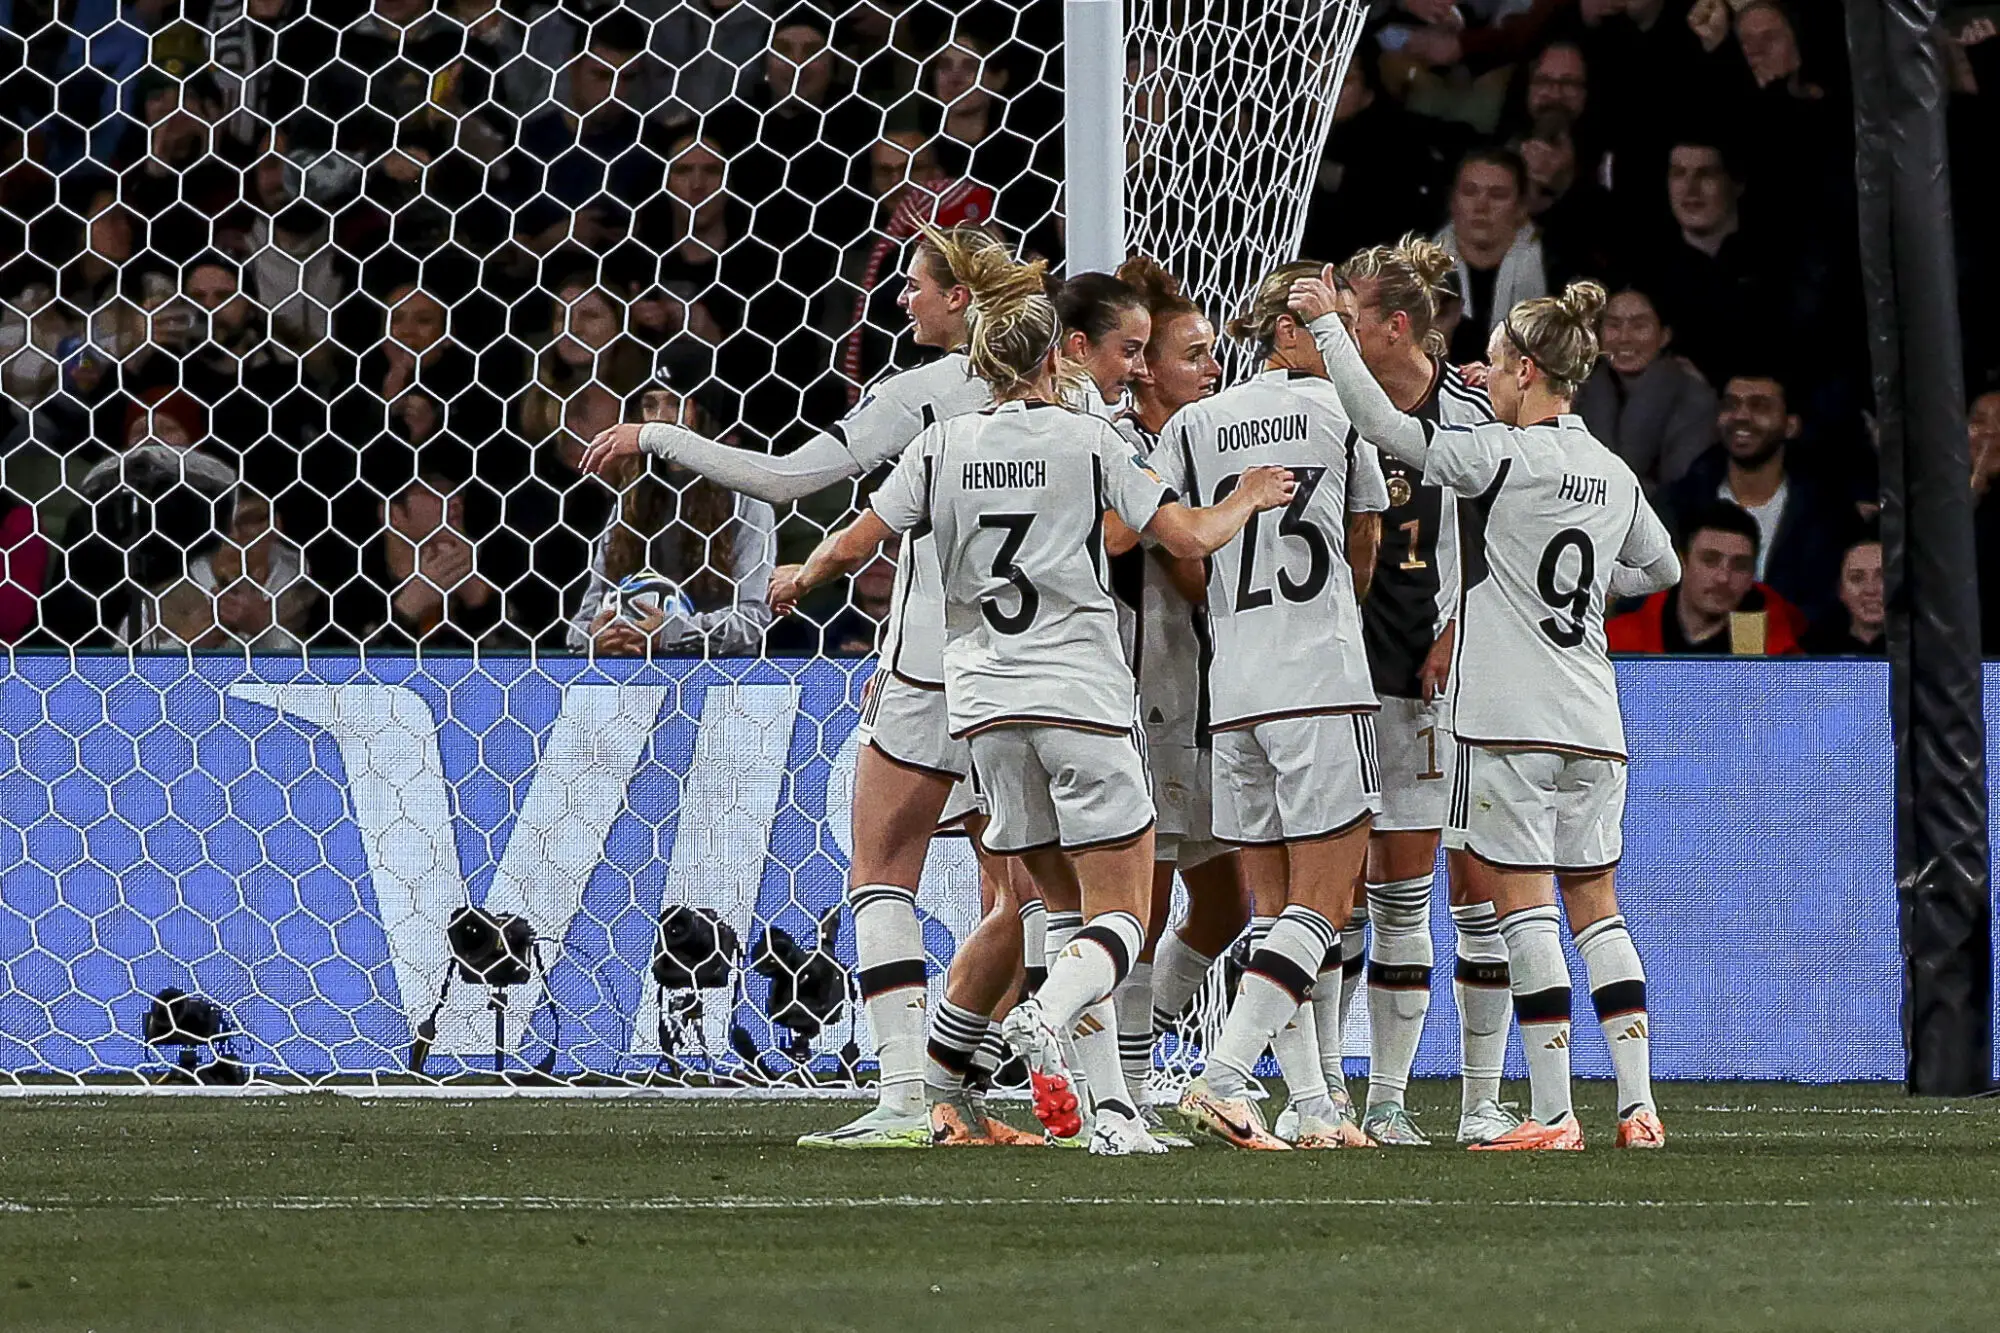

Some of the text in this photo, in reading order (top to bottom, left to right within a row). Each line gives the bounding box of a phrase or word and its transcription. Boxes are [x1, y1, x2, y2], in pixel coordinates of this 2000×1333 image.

[1217, 415, 1308, 453] DOORSOUN
[962, 460, 1047, 490] HENDRICH
[1557, 473, 1607, 506] HUTH
[1213, 466, 1331, 613] 23
[1399, 518, 1427, 571] 1
[977, 512, 1041, 635] 3
[1535, 527, 1595, 649] 9
[1414, 725, 1445, 781] 1
[226, 684, 988, 1055] VI
